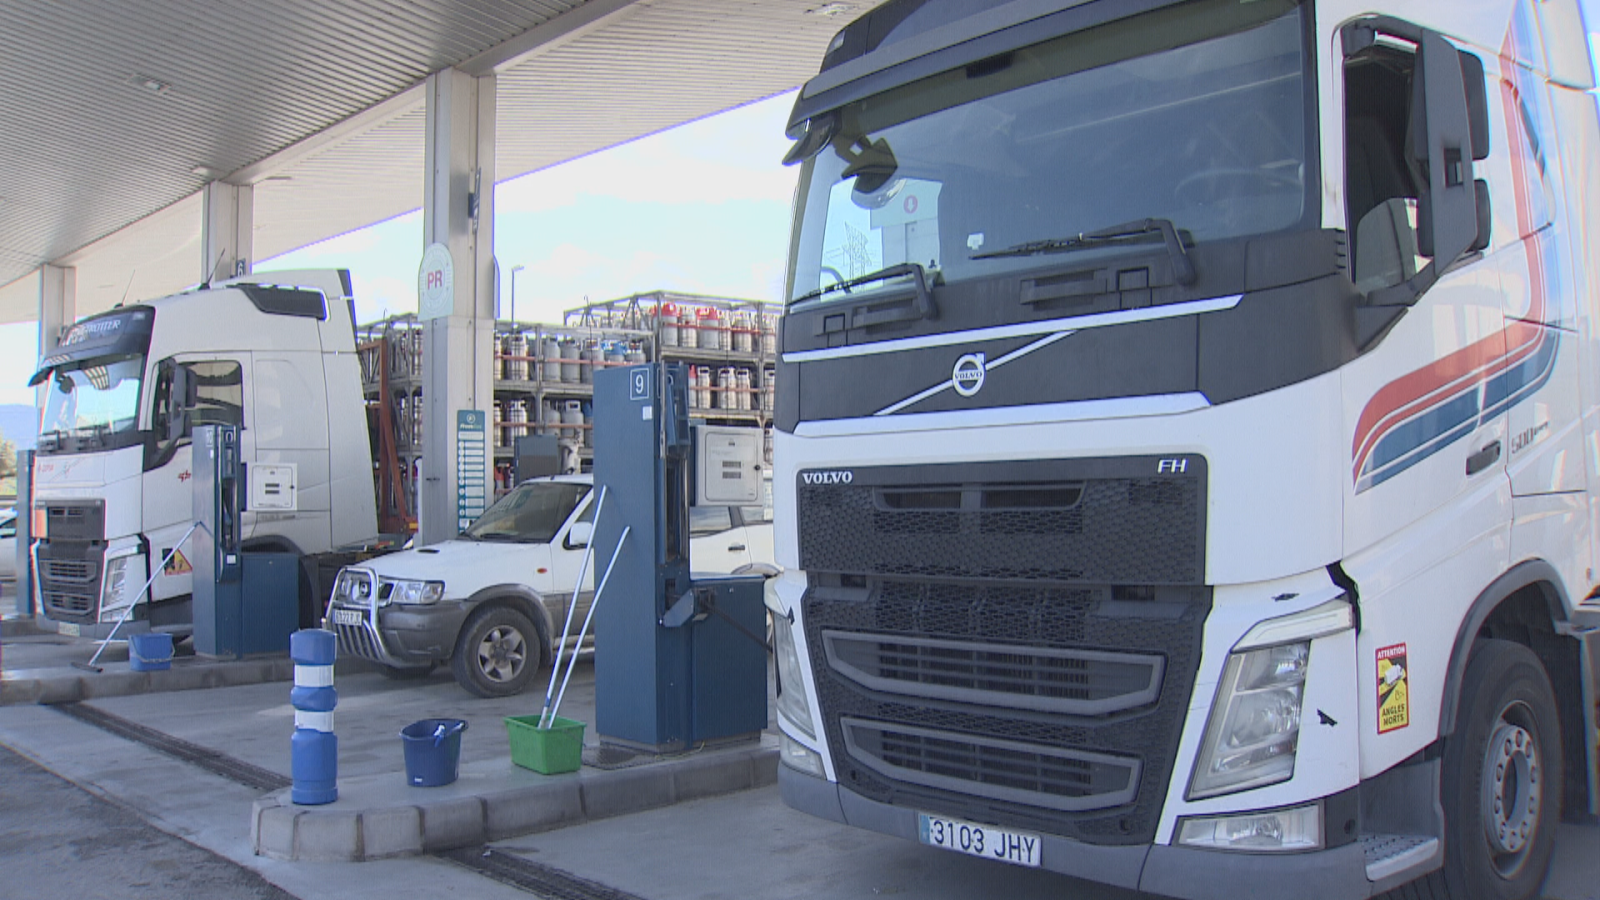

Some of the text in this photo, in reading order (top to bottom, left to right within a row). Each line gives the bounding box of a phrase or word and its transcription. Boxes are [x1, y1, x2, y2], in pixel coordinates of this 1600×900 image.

[427, 269, 443, 290] PR
[954, 371, 983, 380] VOLVO
[635, 374, 644, 394] 9
[1157, 458, 1188, 474] FH
[802, 471, 853, 485] VOLVO
[1377, 646, 1405, 659] ATTENTION
[1382, 704, 1404, 716] ANGLES
[1383, 714, 1404, 726] MORTS
[933, 820, 1036, 863] 3103 JHY
